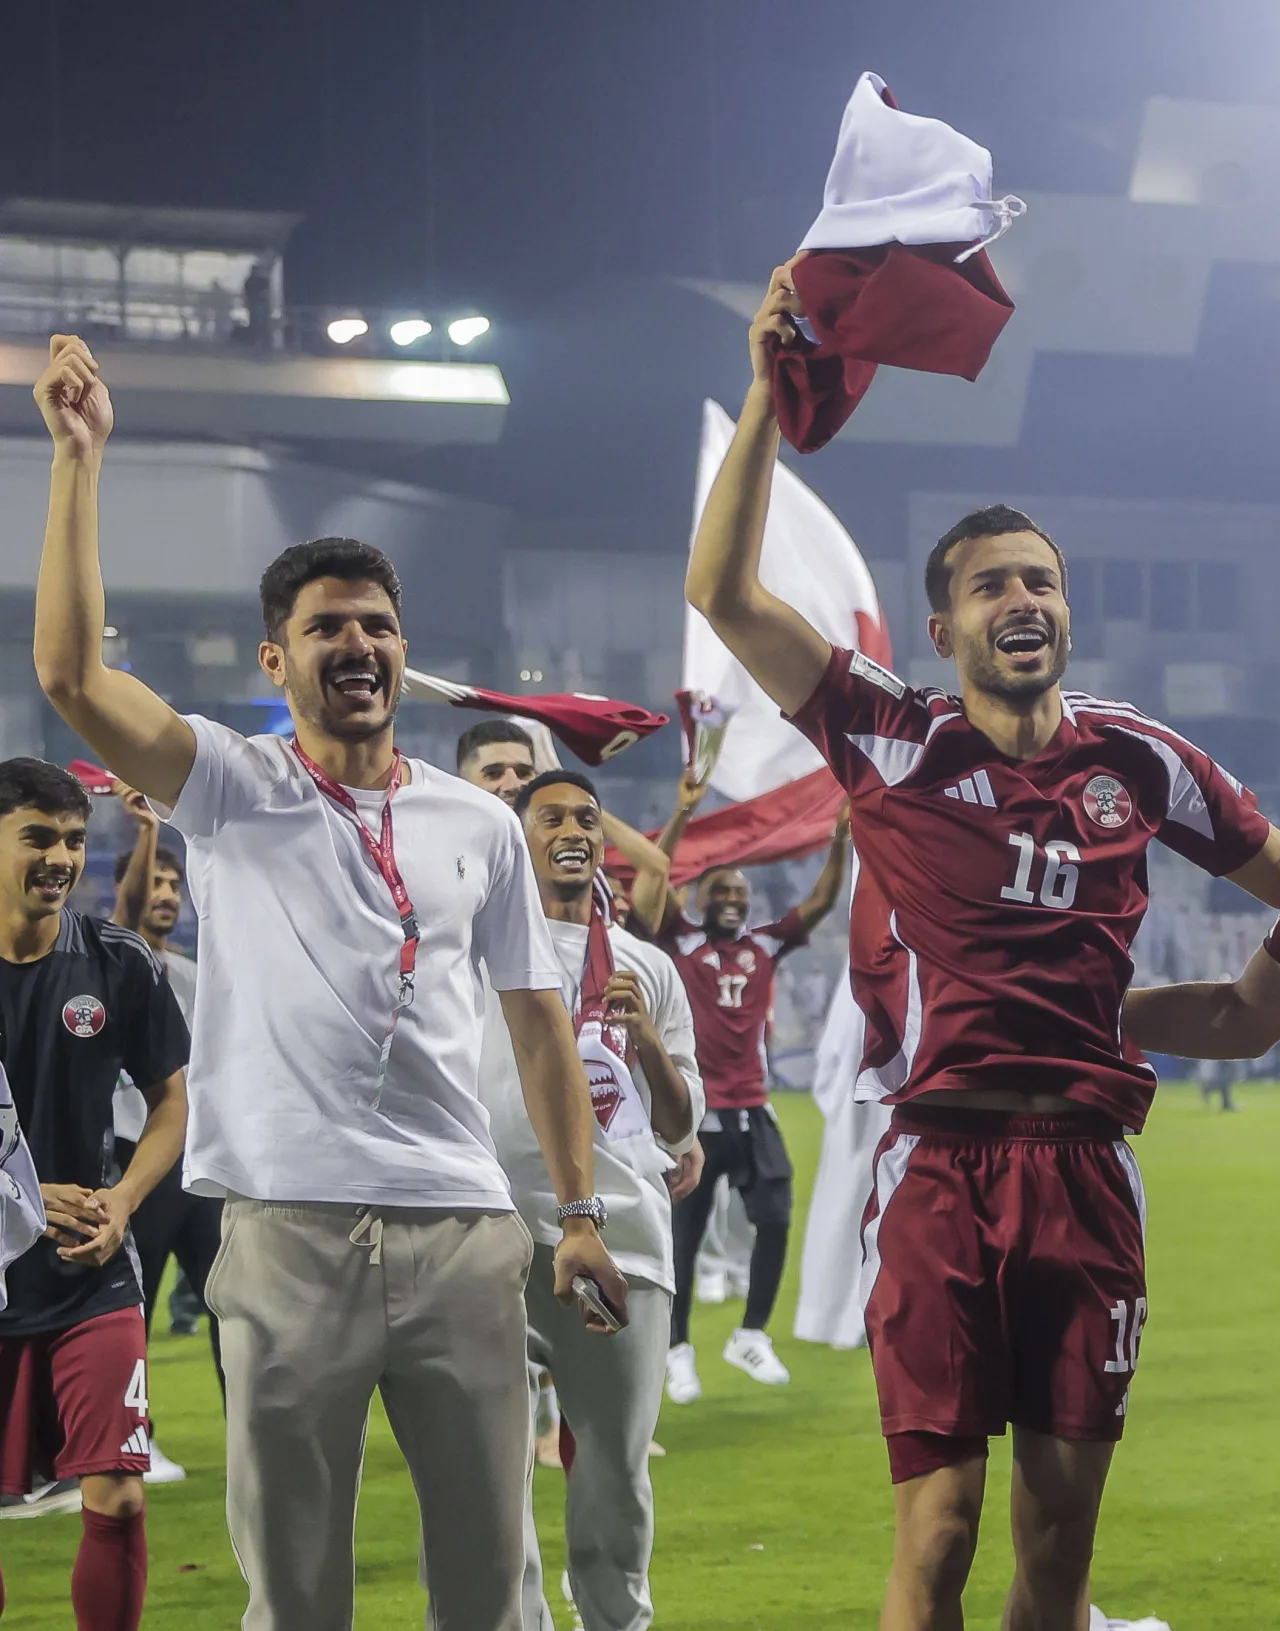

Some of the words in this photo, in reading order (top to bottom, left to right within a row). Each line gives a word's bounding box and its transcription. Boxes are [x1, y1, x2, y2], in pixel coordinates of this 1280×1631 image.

[1001, 832, 1081, 909] 16
[716, 974, 748, 1008] 17
[1104, 1297, 1147, 1372] 16
[124, 1358, 149, 1418] 4
